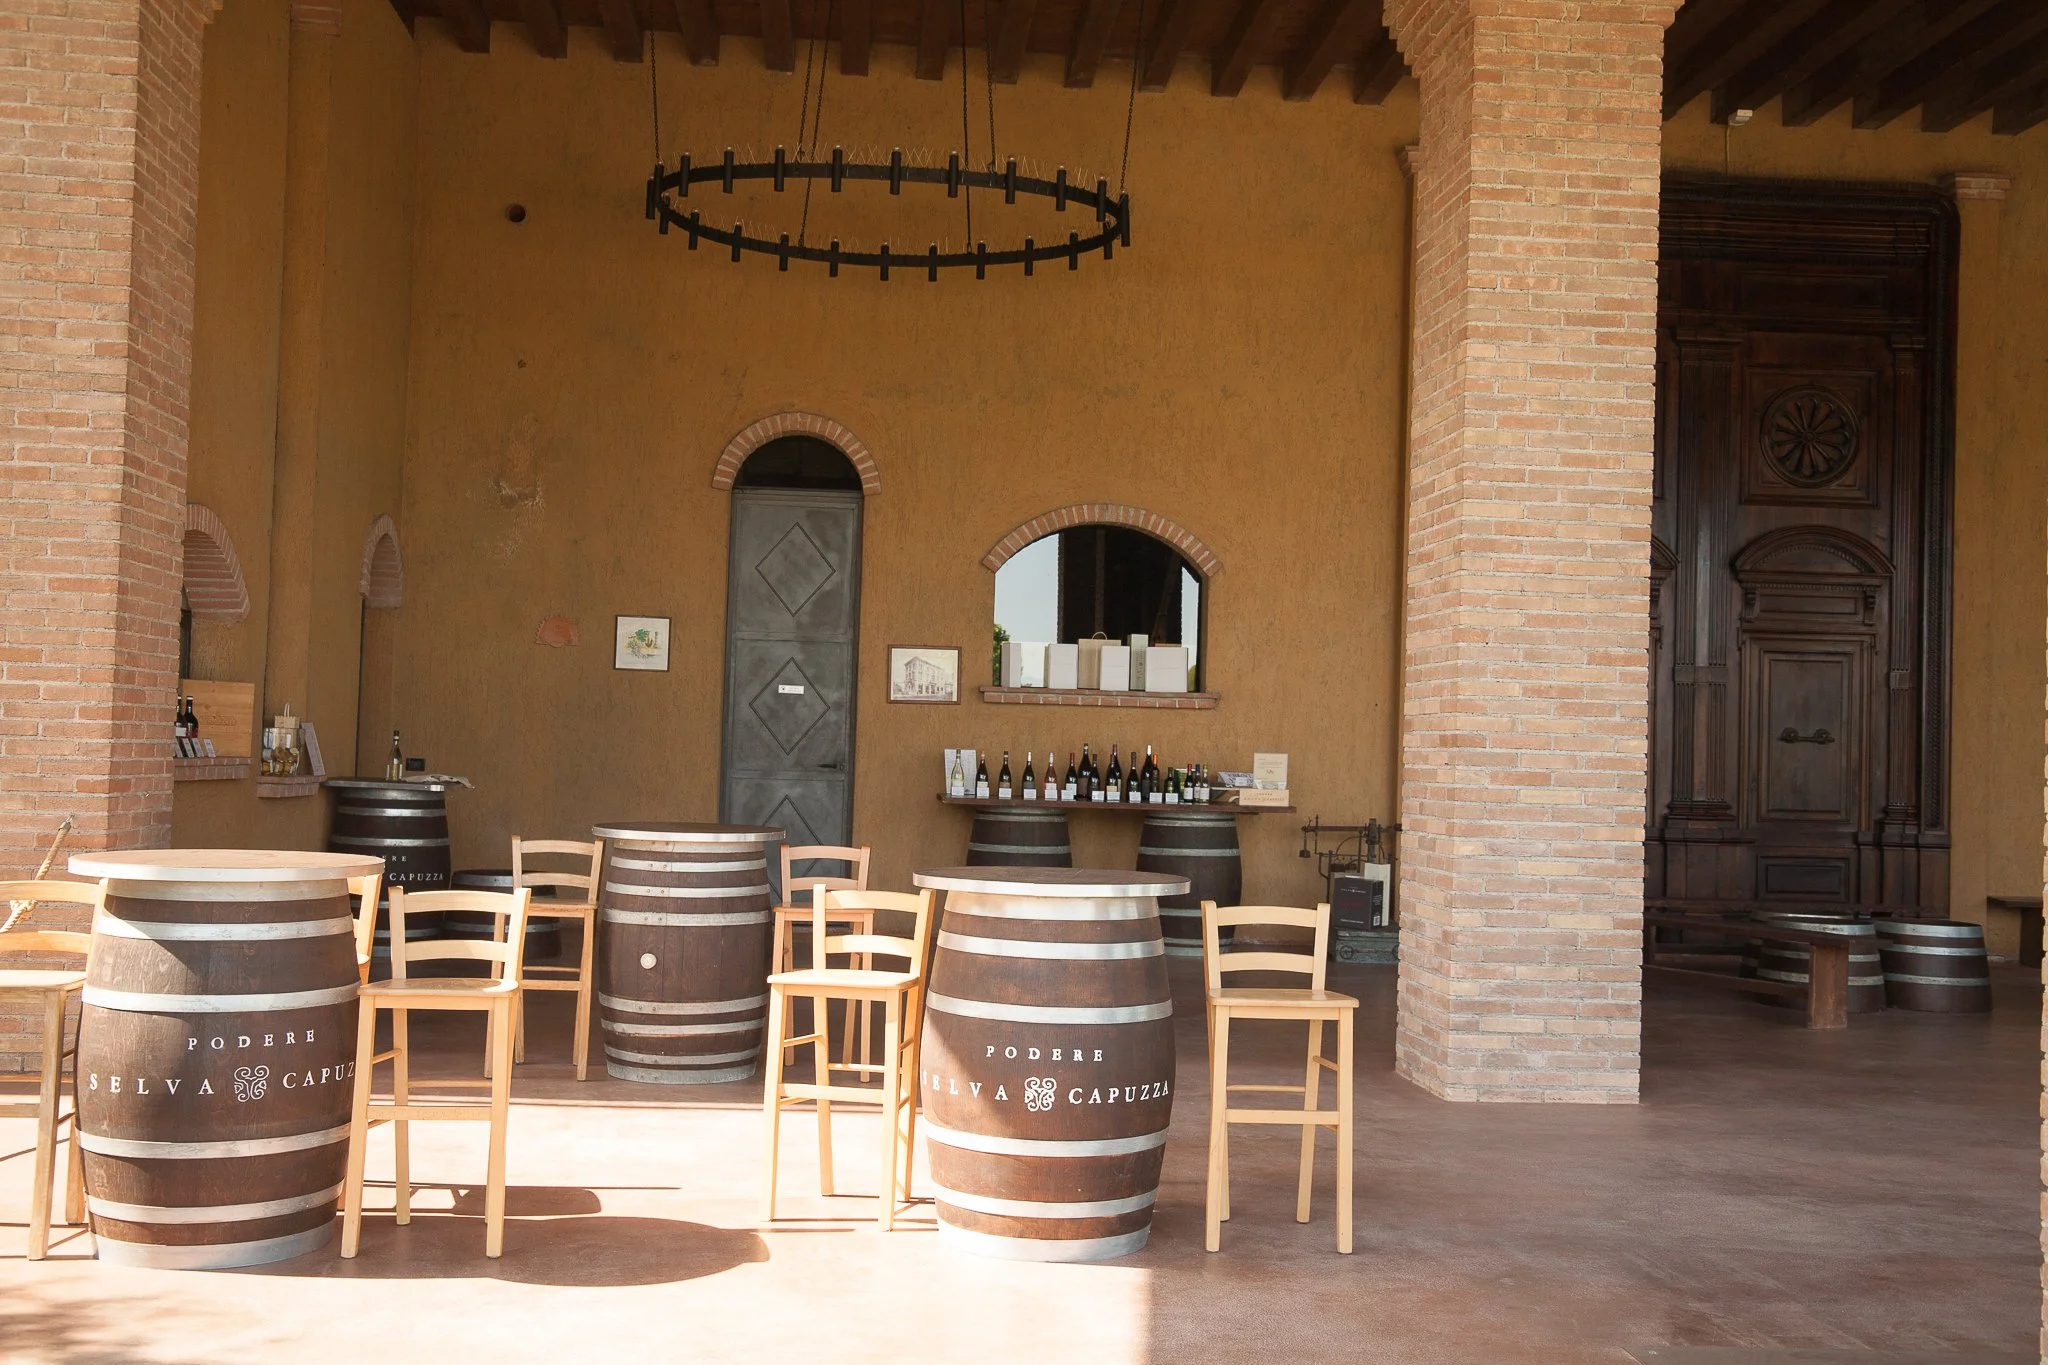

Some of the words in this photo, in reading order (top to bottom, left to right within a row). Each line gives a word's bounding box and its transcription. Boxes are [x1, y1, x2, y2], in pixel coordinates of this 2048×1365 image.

[389, 872, 443, 881] CAPUZZA
[187, 1029, 315, 1050] PODERE
[986, 1045, 1103, 1062] PODERE
[89, 1072, 214, 1095] SELVA
[282, 1061, 355, 1089] CAPUZ
[922, 1071, 1009, 1101] SELVA
[1068, 1079, 1169, 1105] CAPUZZA
